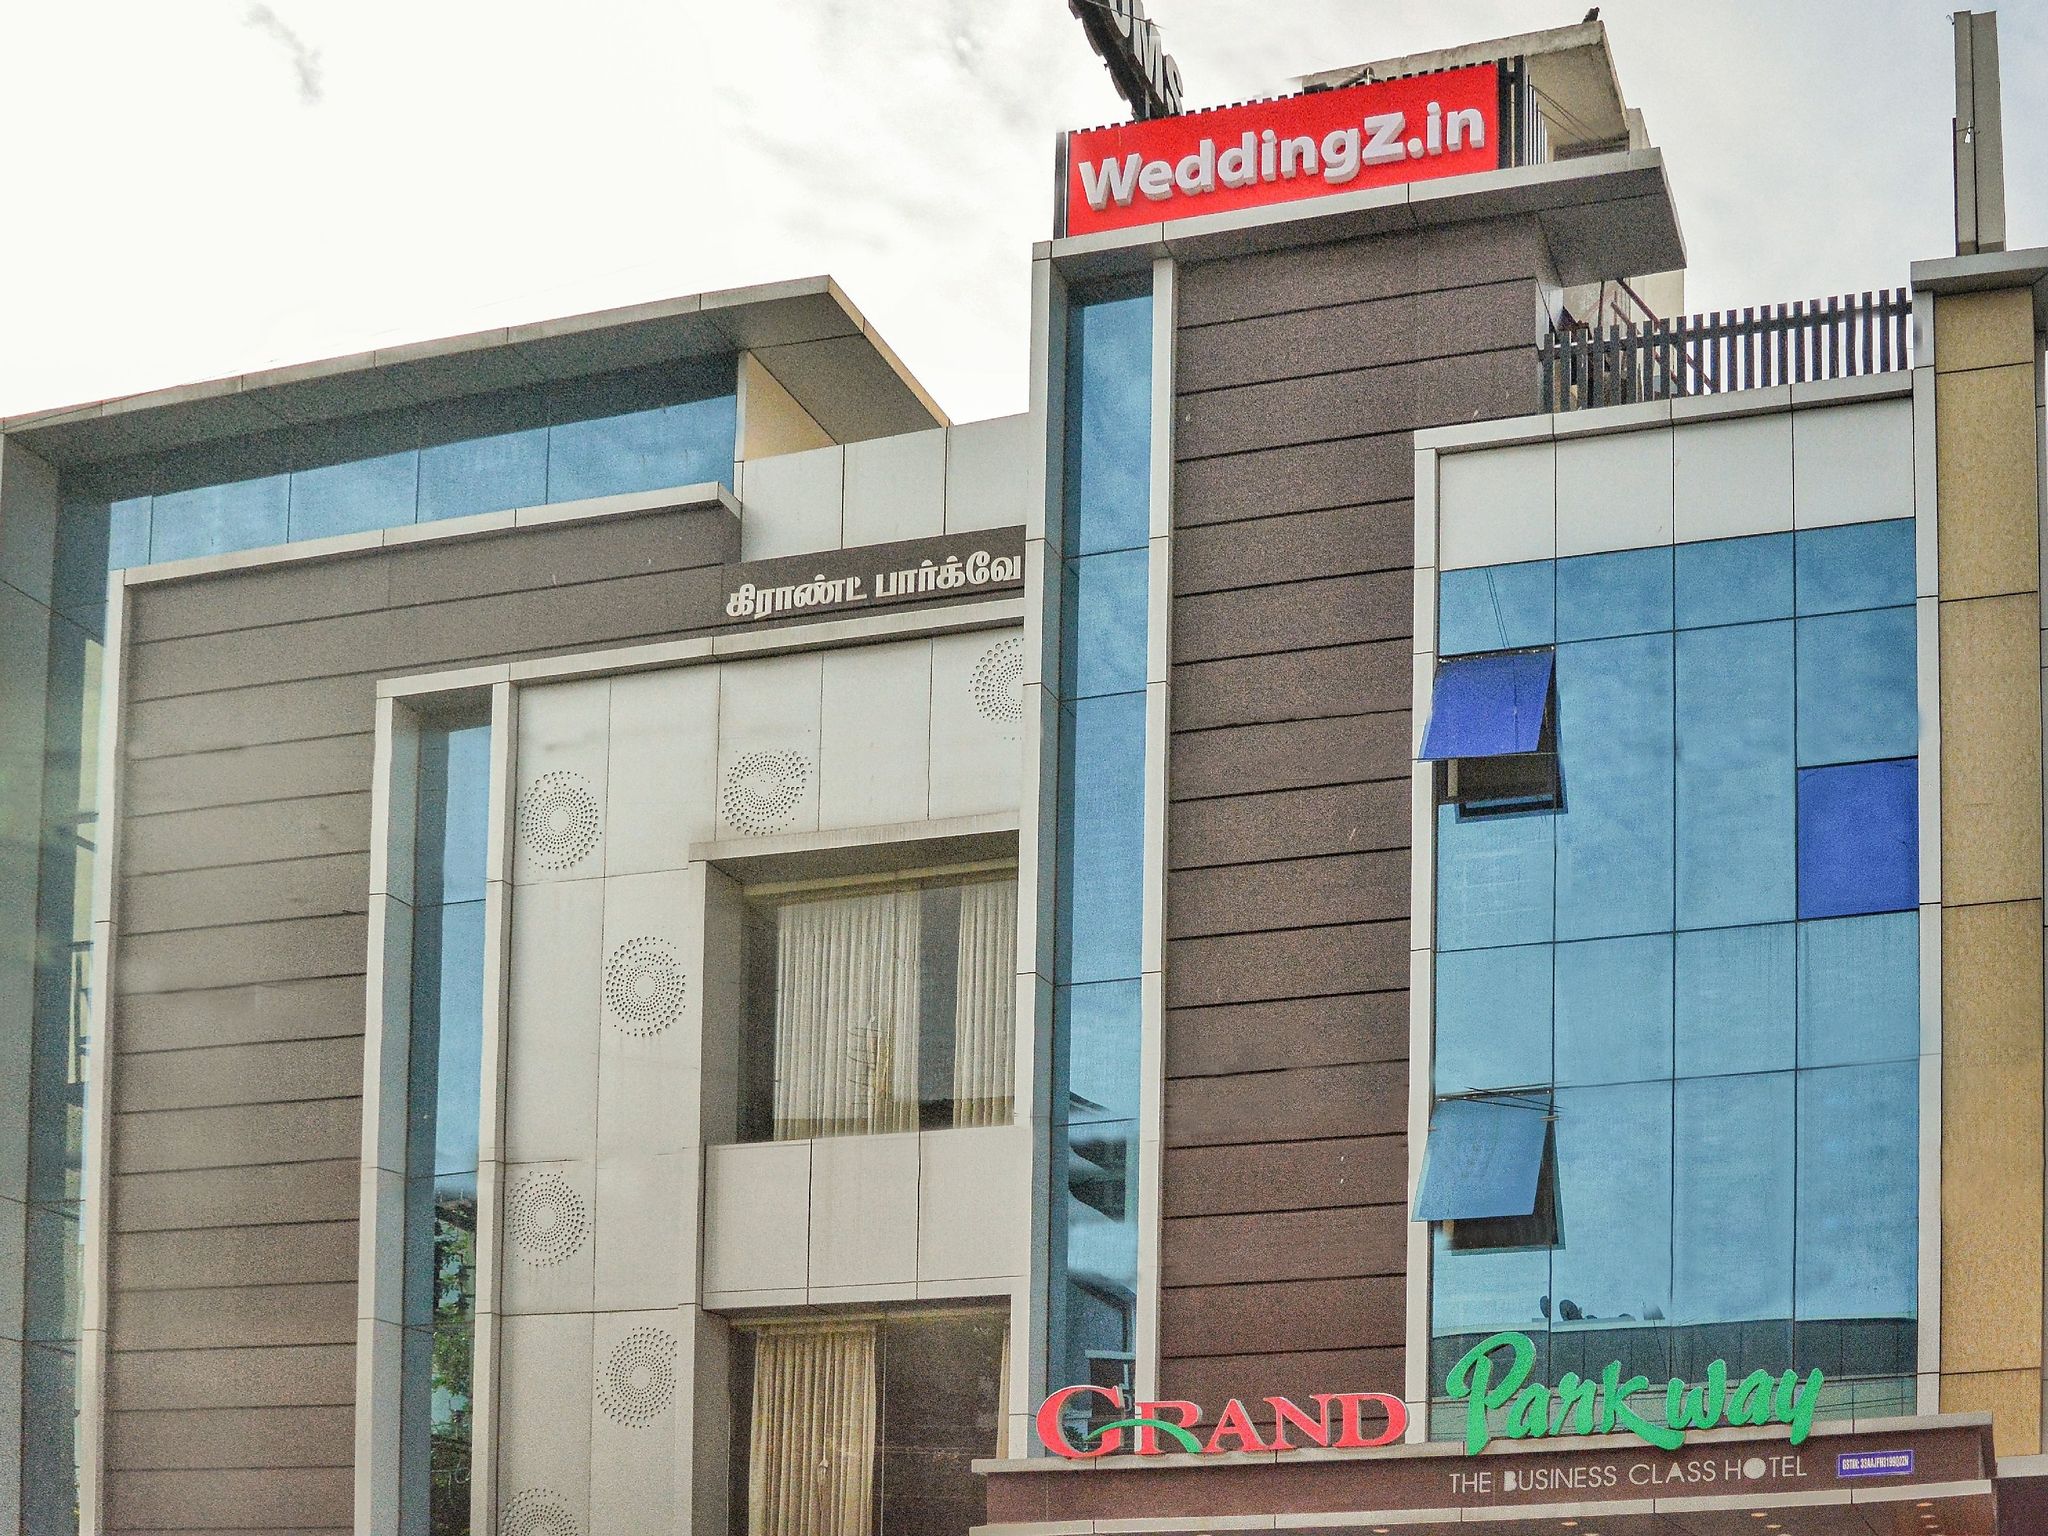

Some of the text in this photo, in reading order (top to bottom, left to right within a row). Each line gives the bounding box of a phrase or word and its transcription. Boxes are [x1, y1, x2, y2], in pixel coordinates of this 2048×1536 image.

[875, 550, 1021, 597] பார்க்வே
[1036, 1384, 1410, 1460] GRAND
[1449, 1455, 1807, 1494] THE BUSINESS CLASS HOTEL
